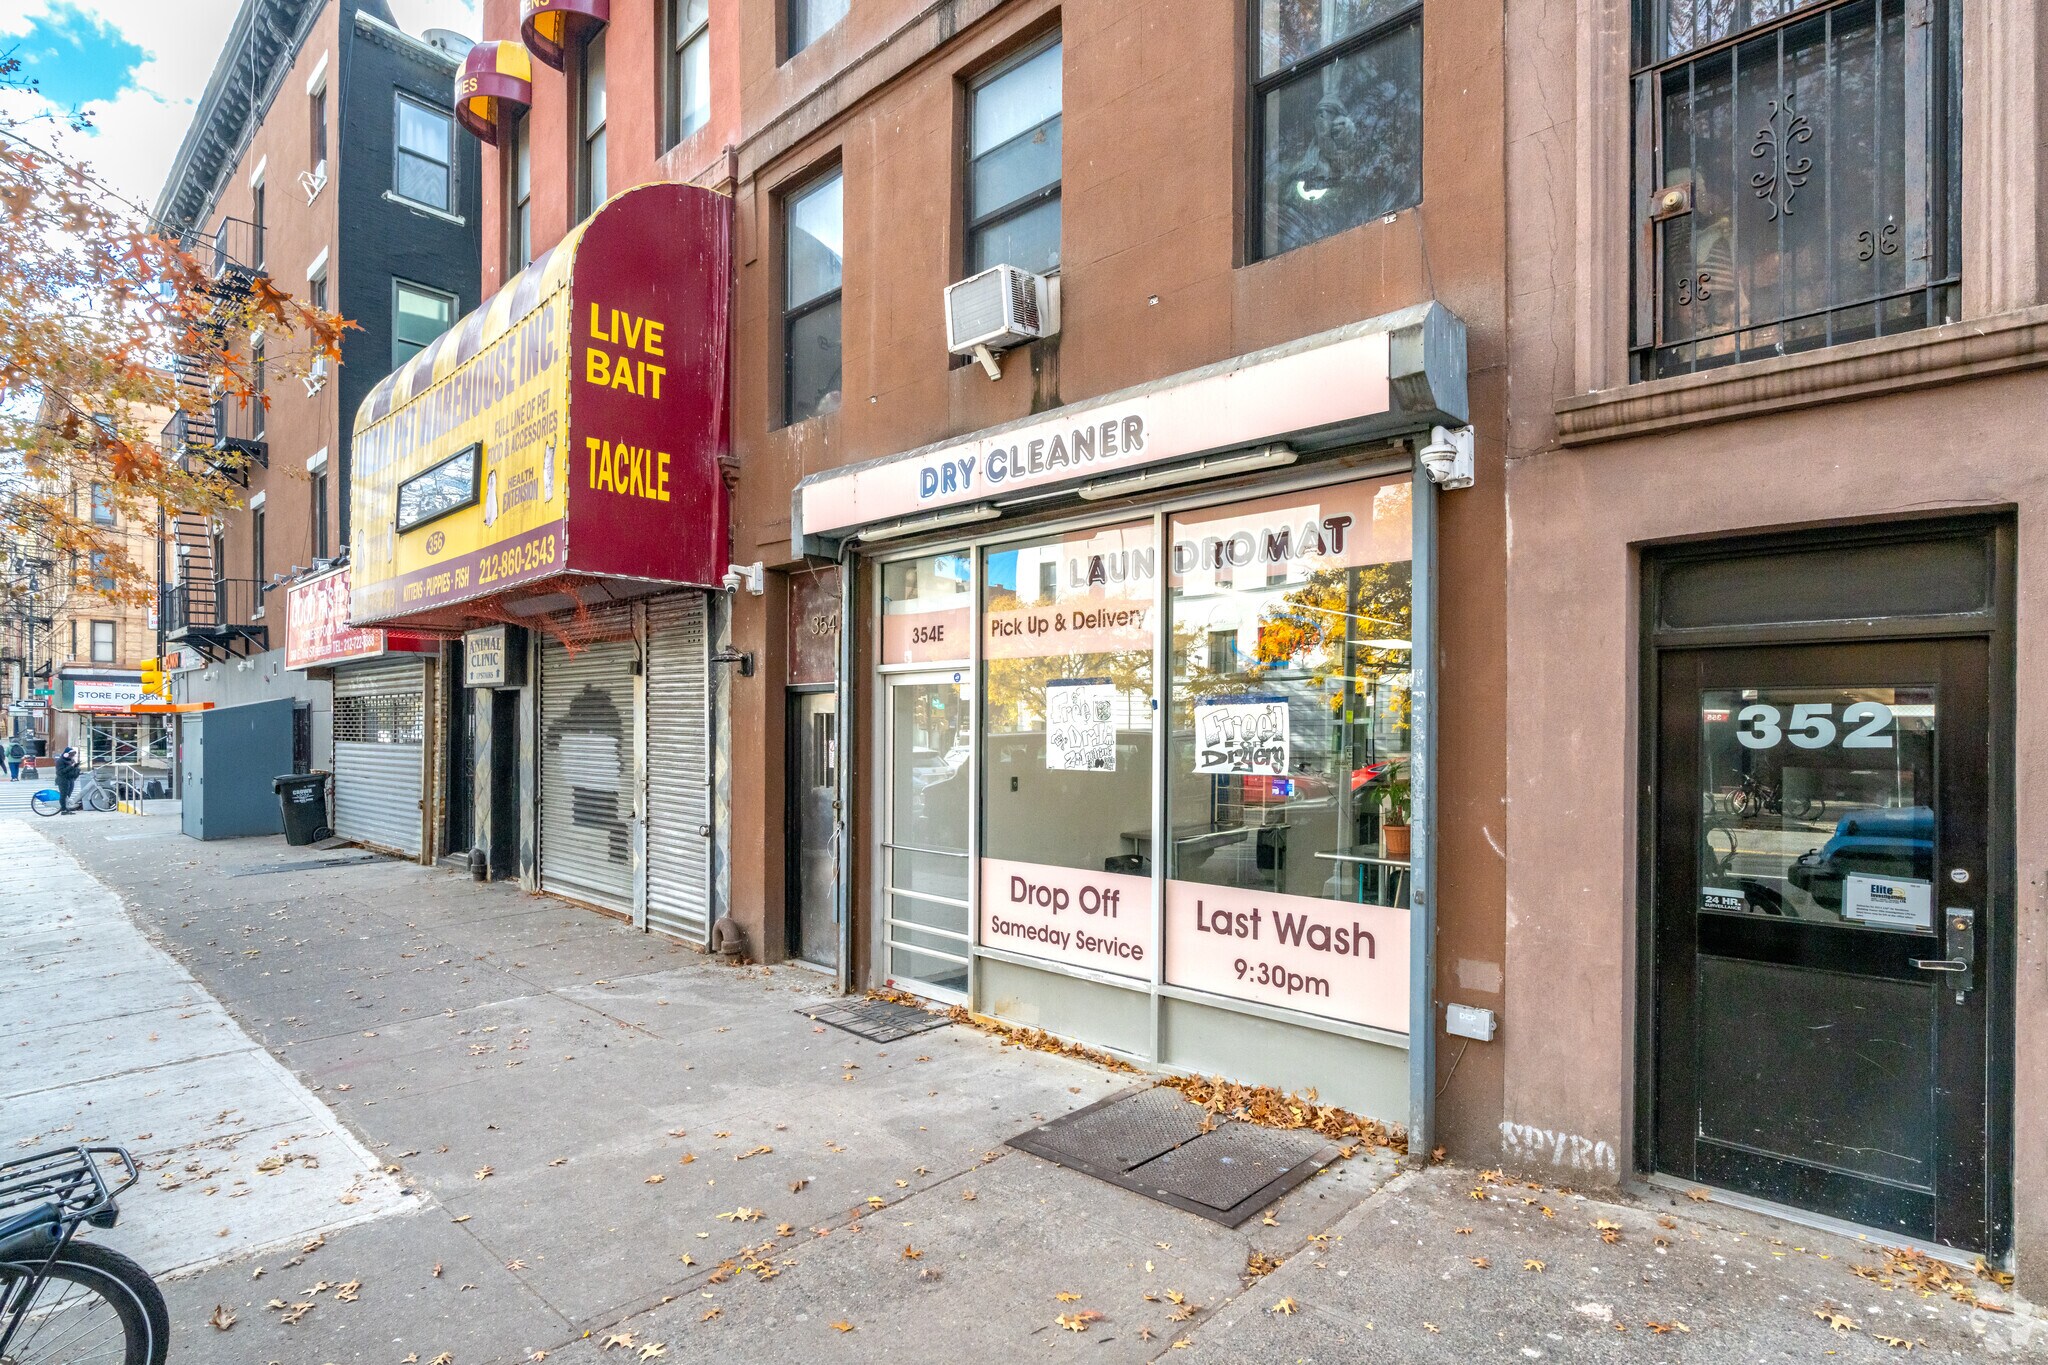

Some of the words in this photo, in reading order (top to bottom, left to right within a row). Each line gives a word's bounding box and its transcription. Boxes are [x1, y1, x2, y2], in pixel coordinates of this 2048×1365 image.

[590, 302, 665, 357] LIVE
[393, 405, 416, 462] PET
[419, 335, 516, 449] WAREHOUSE
[519, 305, 559, 386] INC.
[586, 347, 667, 400] BAIT
[495, 414, 510, 440] FULL
[511, 404, 526, 431] LINE
[526, 397, 536, 422] OF
[537, 388, 551, 414] PET
[511, 409, 558, 454] ACCESSORIES
[508, 466, 534, 489] HEALTH
[586, 436, 671, 502] TACKLE
[920, 456, 977, 500] DRY
[985, 414, 1145, 483] CLEANER
[502, 478, 539, 515] EXTENSION
[428, 533, 443, 553] 356
[426, 571, 451, 597] PUPPIES
[454, 566, 470, 590] FISH
[478, 534, 556, 586] 212-860-2543
[810, 613, 837, 635] 354
[912, 624, 945, 644] 354E
[991, 618, 1022, 637] Pick
[1028, 616, 1049, 638] Up
[1055, 612, 1066, 632] &
[1072, 608, 1147, 631] Delivery
[469, 637, 502, 654] ANIMAL
[471, 652, 499, 667] CLINIC
[78, 691, 111, 700] STORE
[115, 692, 136, 700] FOR
[1202, 707, 1275, 748] Free
[1735, 701, 1893, 749] 352
[1200, 746, 1285, 775] Dryers
[1010, 874, 1070, 916] Drop
[1078, 884, 1120, 919] Off
[1704, 902, 1742, 911] SURVEILLANCE
[1705, 896, 1720, 904] 24
[1722, 897, 1742, 906] HR.
[1870, 884, 1894, 895] Elite
[991, 915, 1071, 951] Sameday
[1075, 930, 1144, 962] Service
[1196, 899, 1262, 941] Last
[1271, 910, 1376, 959] Wash
[1233, 957, 1330, 998] 9:30pm
